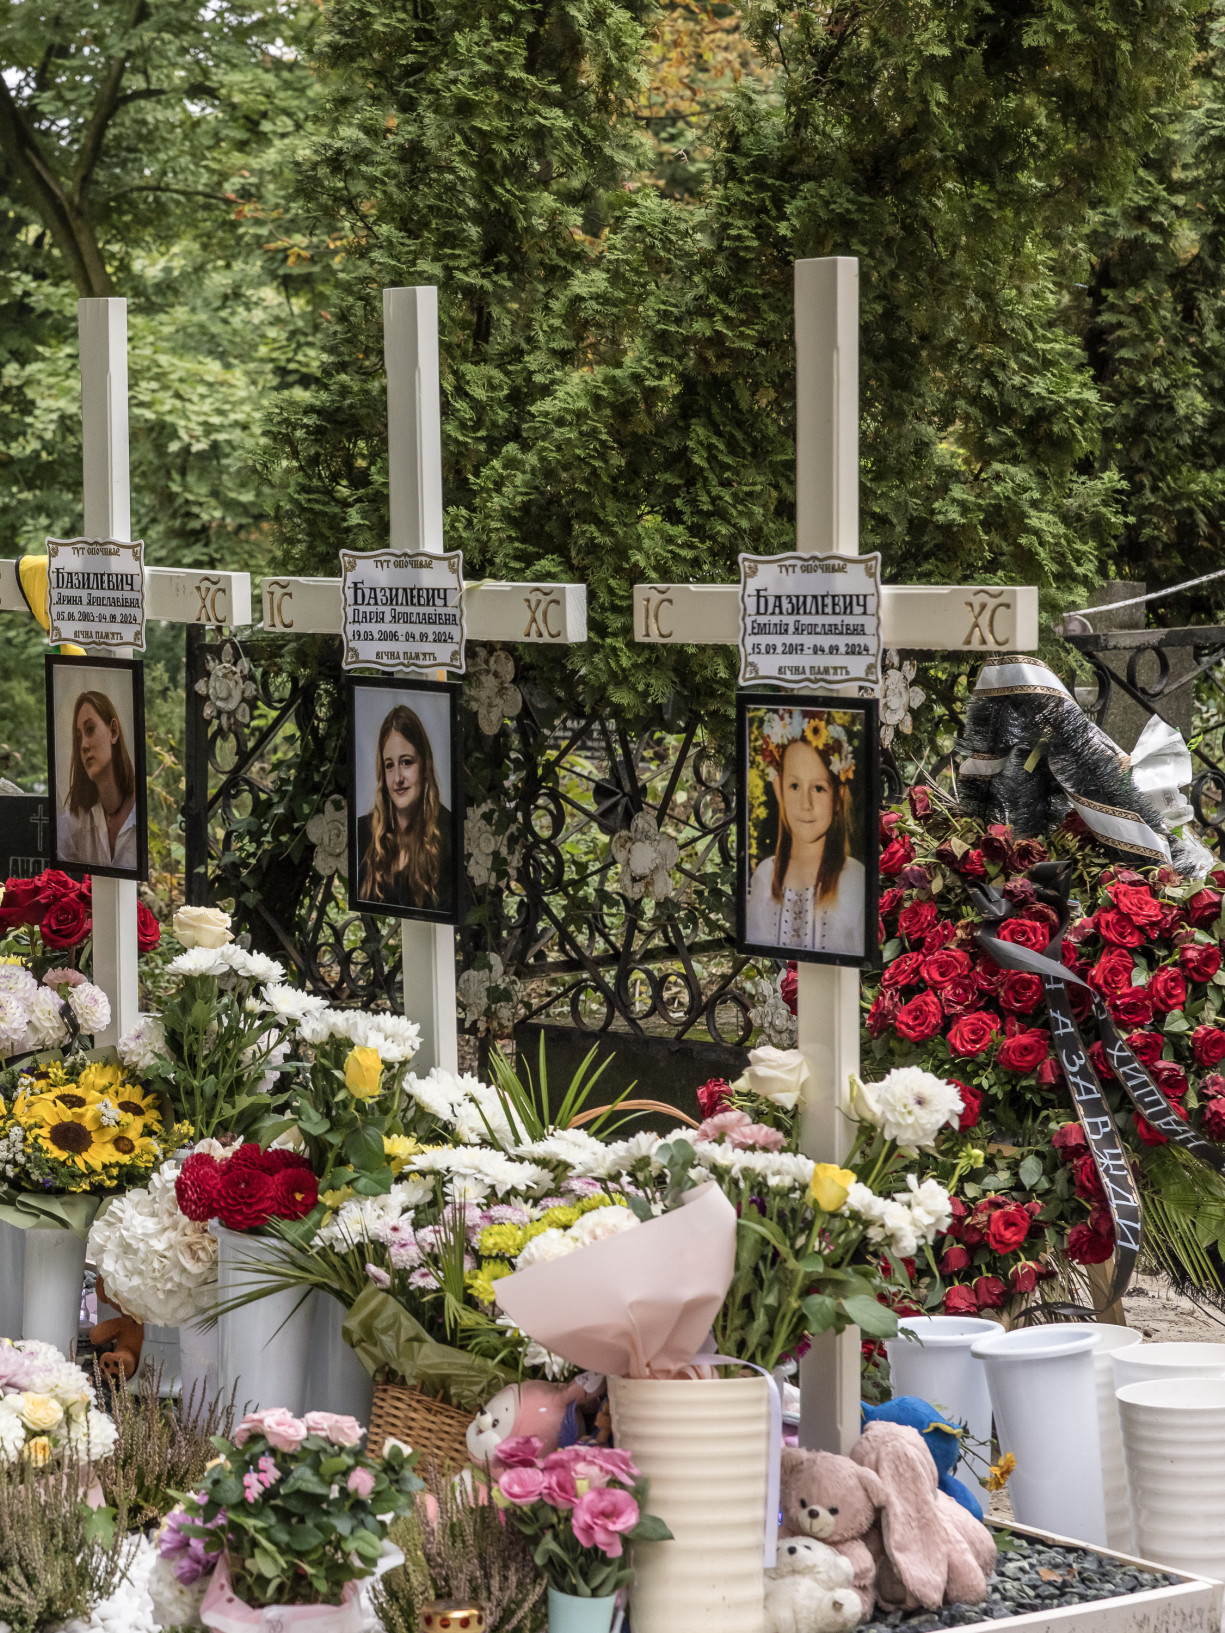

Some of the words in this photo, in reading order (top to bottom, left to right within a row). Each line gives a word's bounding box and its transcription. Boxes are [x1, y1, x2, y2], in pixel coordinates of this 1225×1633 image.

[374, 560, 391, 571] ТУТ
[778, 564, 798, 576] ТУТ
[55, 566, 134, 591] БАЗИЛЕВИЧ
[352, 580, 448, 607] БАЗИЛЕВИЧ
[754, 587, 868, 615] БАЗИЛЕВИЧ
